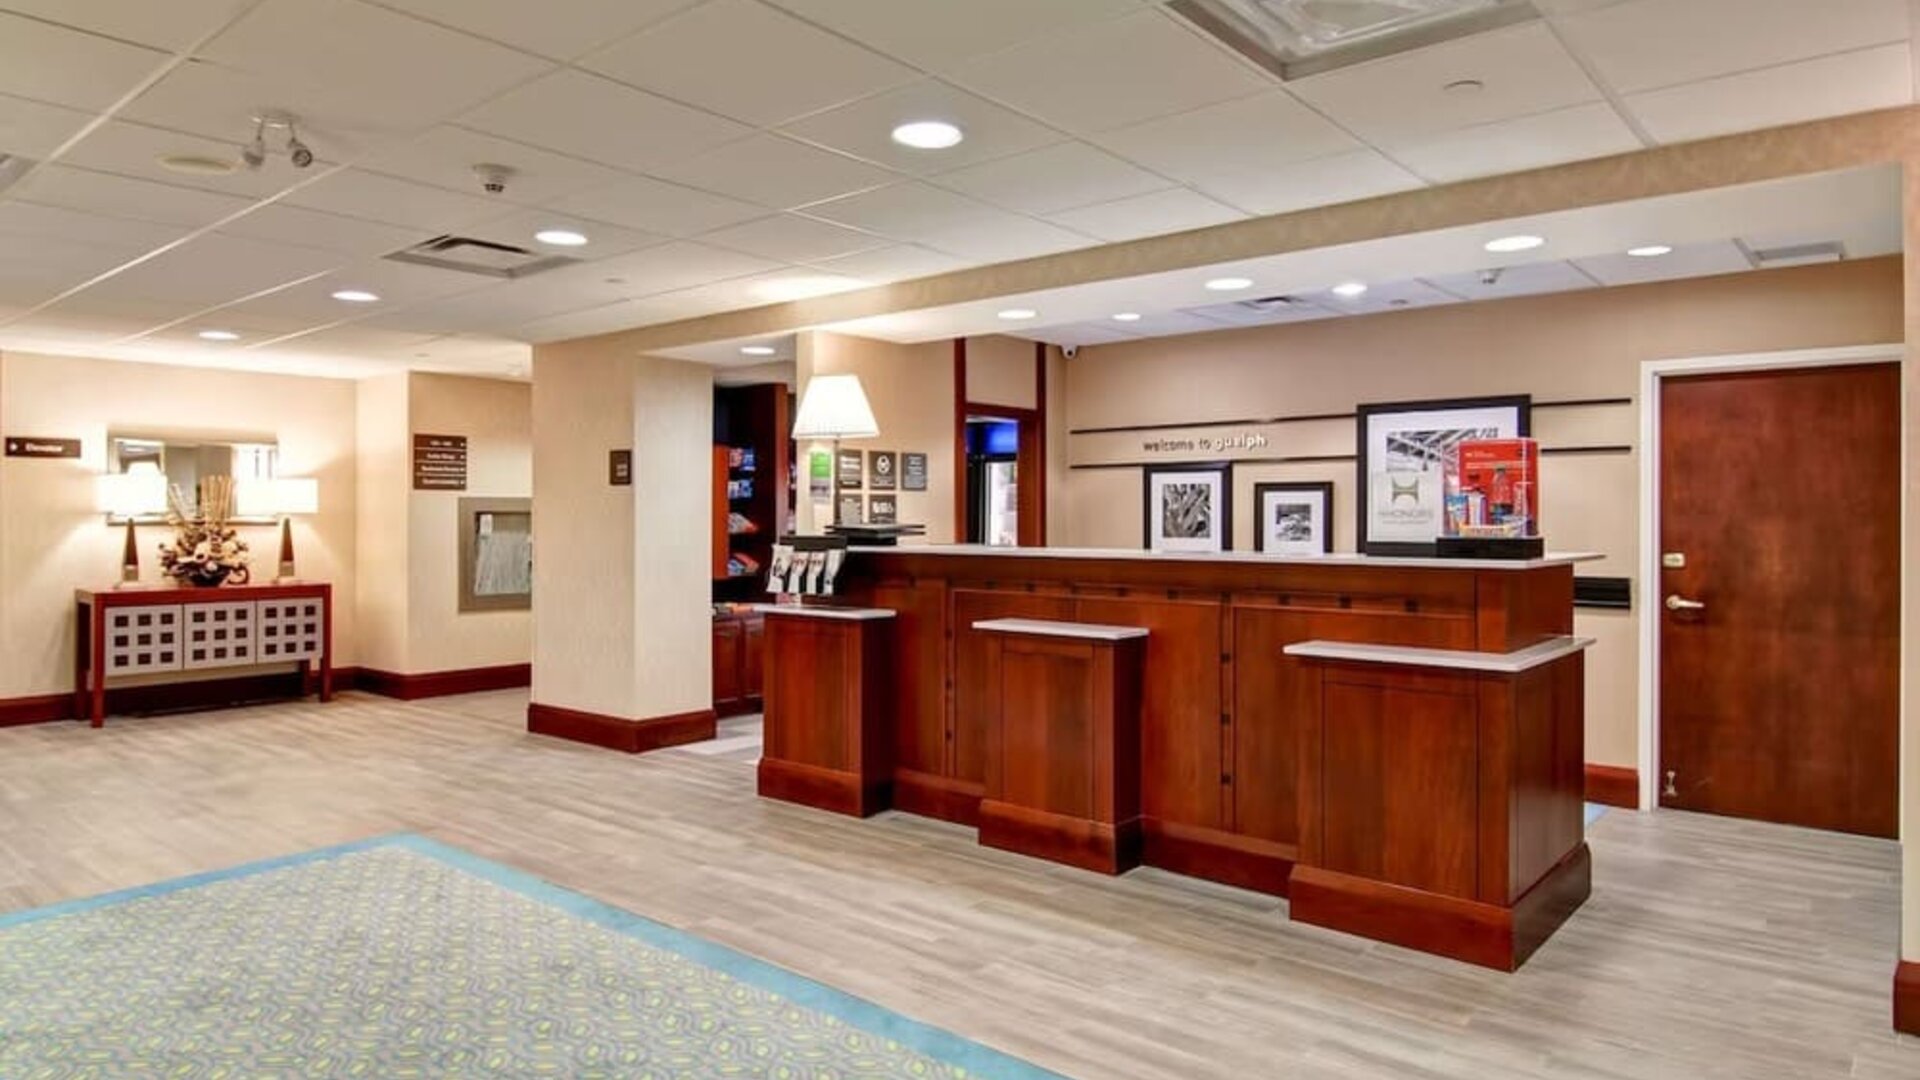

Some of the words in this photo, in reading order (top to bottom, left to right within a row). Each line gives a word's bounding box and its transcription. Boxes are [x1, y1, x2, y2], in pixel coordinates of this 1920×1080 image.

[1143, 438, 1195, 452] welcome
[1198, 438, 1212, 450] to
[1214, 433, 1268, 452] guelph
